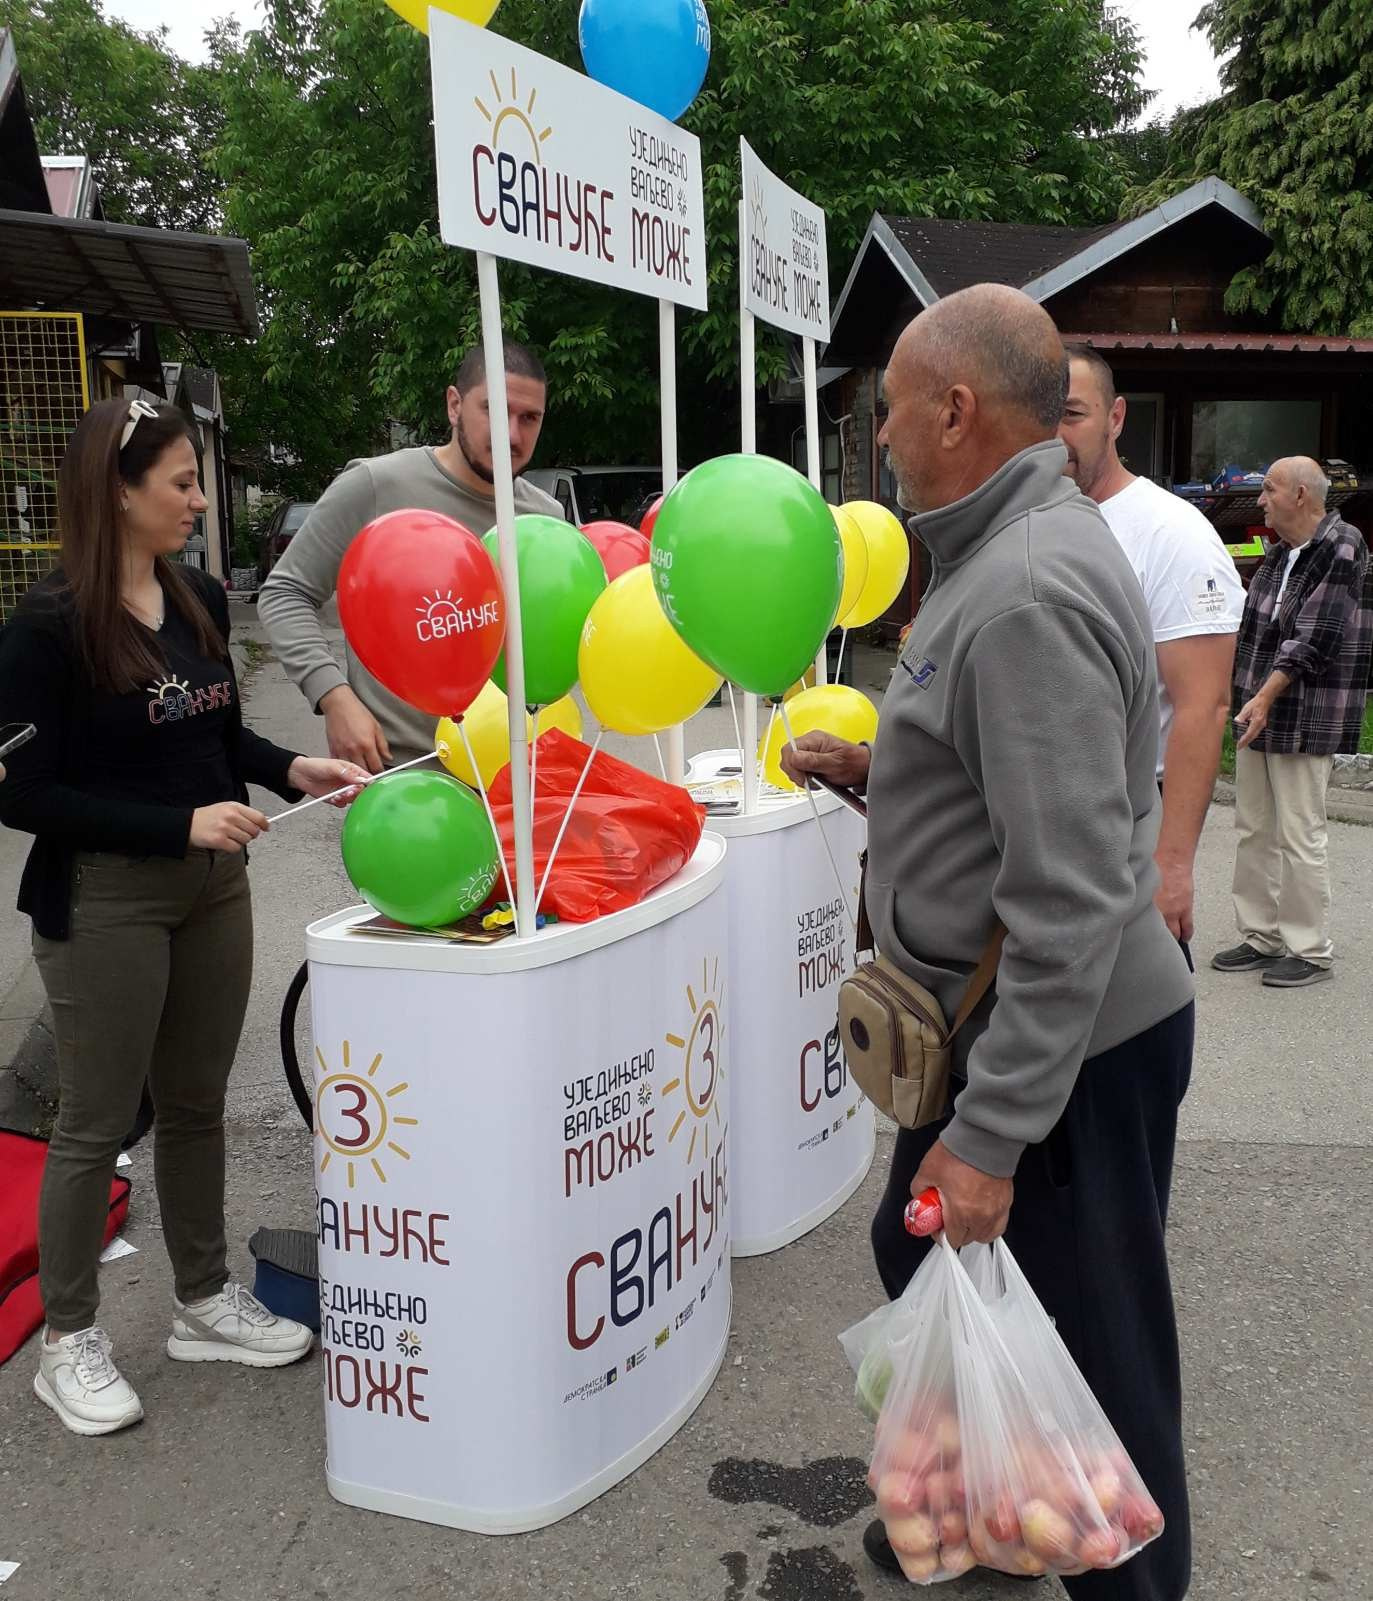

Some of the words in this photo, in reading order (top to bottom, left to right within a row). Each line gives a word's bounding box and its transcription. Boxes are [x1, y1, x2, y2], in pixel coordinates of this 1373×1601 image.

[629, 126, 688, 182] УЈЕДИЊЕНО
[472, 144, 615, 263] СВАНУЋЕ
[631, 166, 674, 212] ВАЉЕВО
[631, 207, 692, 286] МОЖЕ
[751, 234, 788, 312] СВАНУЋЕ
[793, 269, 821, 324] МОЖЕ
[416, 601, 499, 641] СВАНУЋЕ
[148, 681, 231, 724] СВАНУЋЕ
[798, 924, 835, 957] ВАЉЕВО
[799, 939, 845, 998] МОЖЕ
[563, 1048, 655, 1109] УЈЕДИЊЕНО
[699, 1012, 714, 1106] 3
[334, 1083, 371, 1147] 3
[564, 1091, 631, 1141] ВАЉЕВО
[565, 1108, 655, 1198] МОЖЕ
[316, 1190, 450, 1266] АНУЋЕ
[567, 1121, 728, 1350] СВАНУЋЕ
[320, 1276, 427, 1325] ЕДИЊЕНО
[322, 1310, 385, 1352] ЉЕВО
